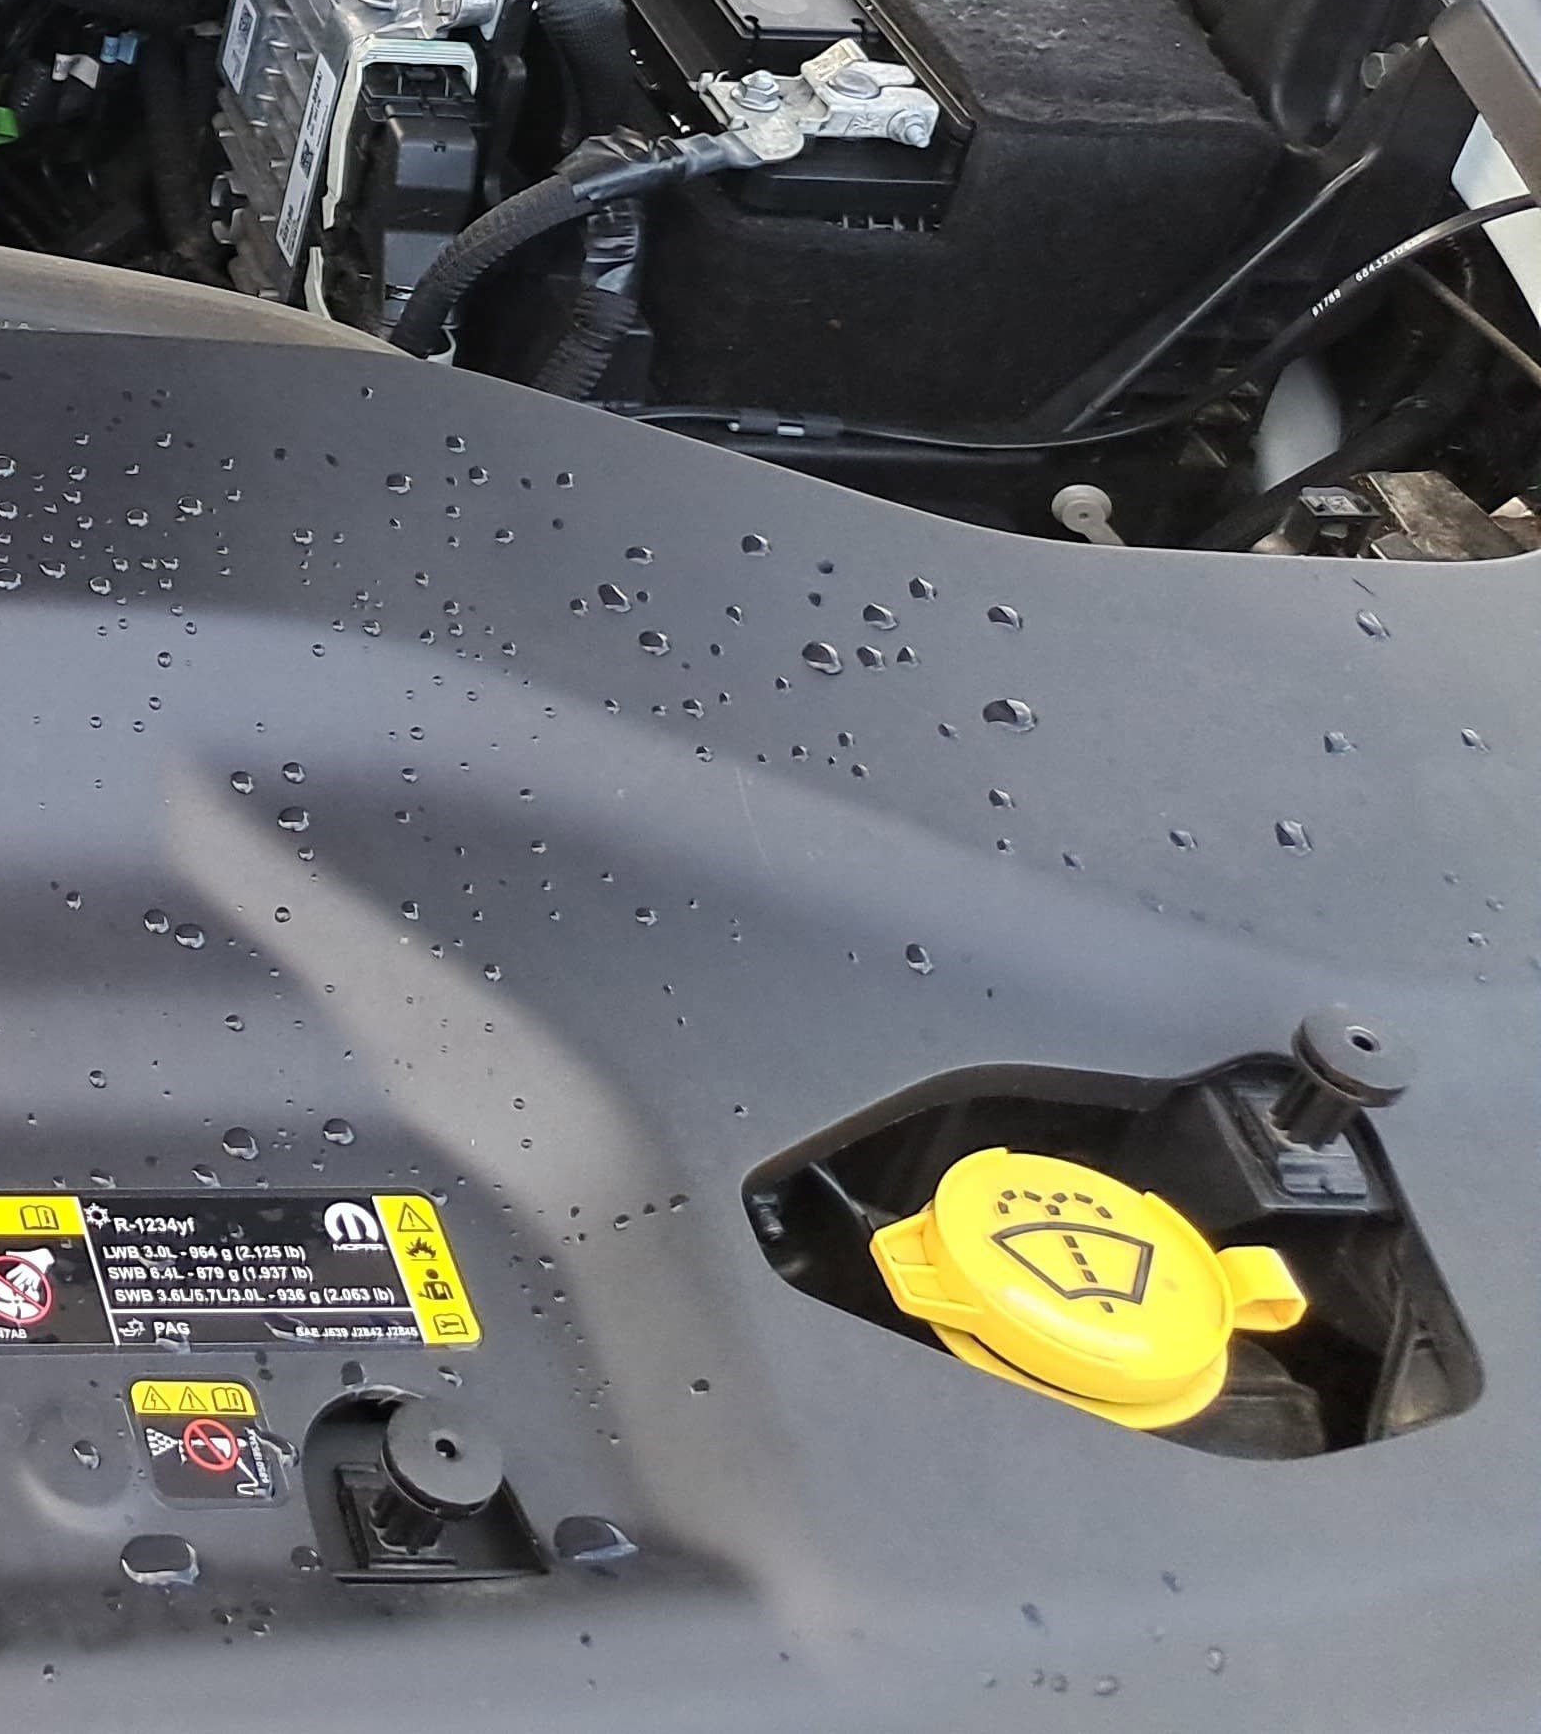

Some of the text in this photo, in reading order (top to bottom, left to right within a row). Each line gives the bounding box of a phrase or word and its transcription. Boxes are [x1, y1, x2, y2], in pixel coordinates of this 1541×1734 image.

[113, 1216, 196, 1238] R-1234yf
[102, 1245, 140, 1259] LWB
[141, 1245, 179, 1259] 3.0L
[235, 1245, 282, 1262] (2.125
[284, 1245, 307, 1264] lb)
[107, 1266, 147, 1280] SWB
[242, 1266, 288, 1283] (1.937
[291, 1266, 313, 1284] lb)
[114, 1288, 154, 1302] SWB
[373, 1287, 395, 1305] lb)
[152, 1320, 191, 1337] PAG
